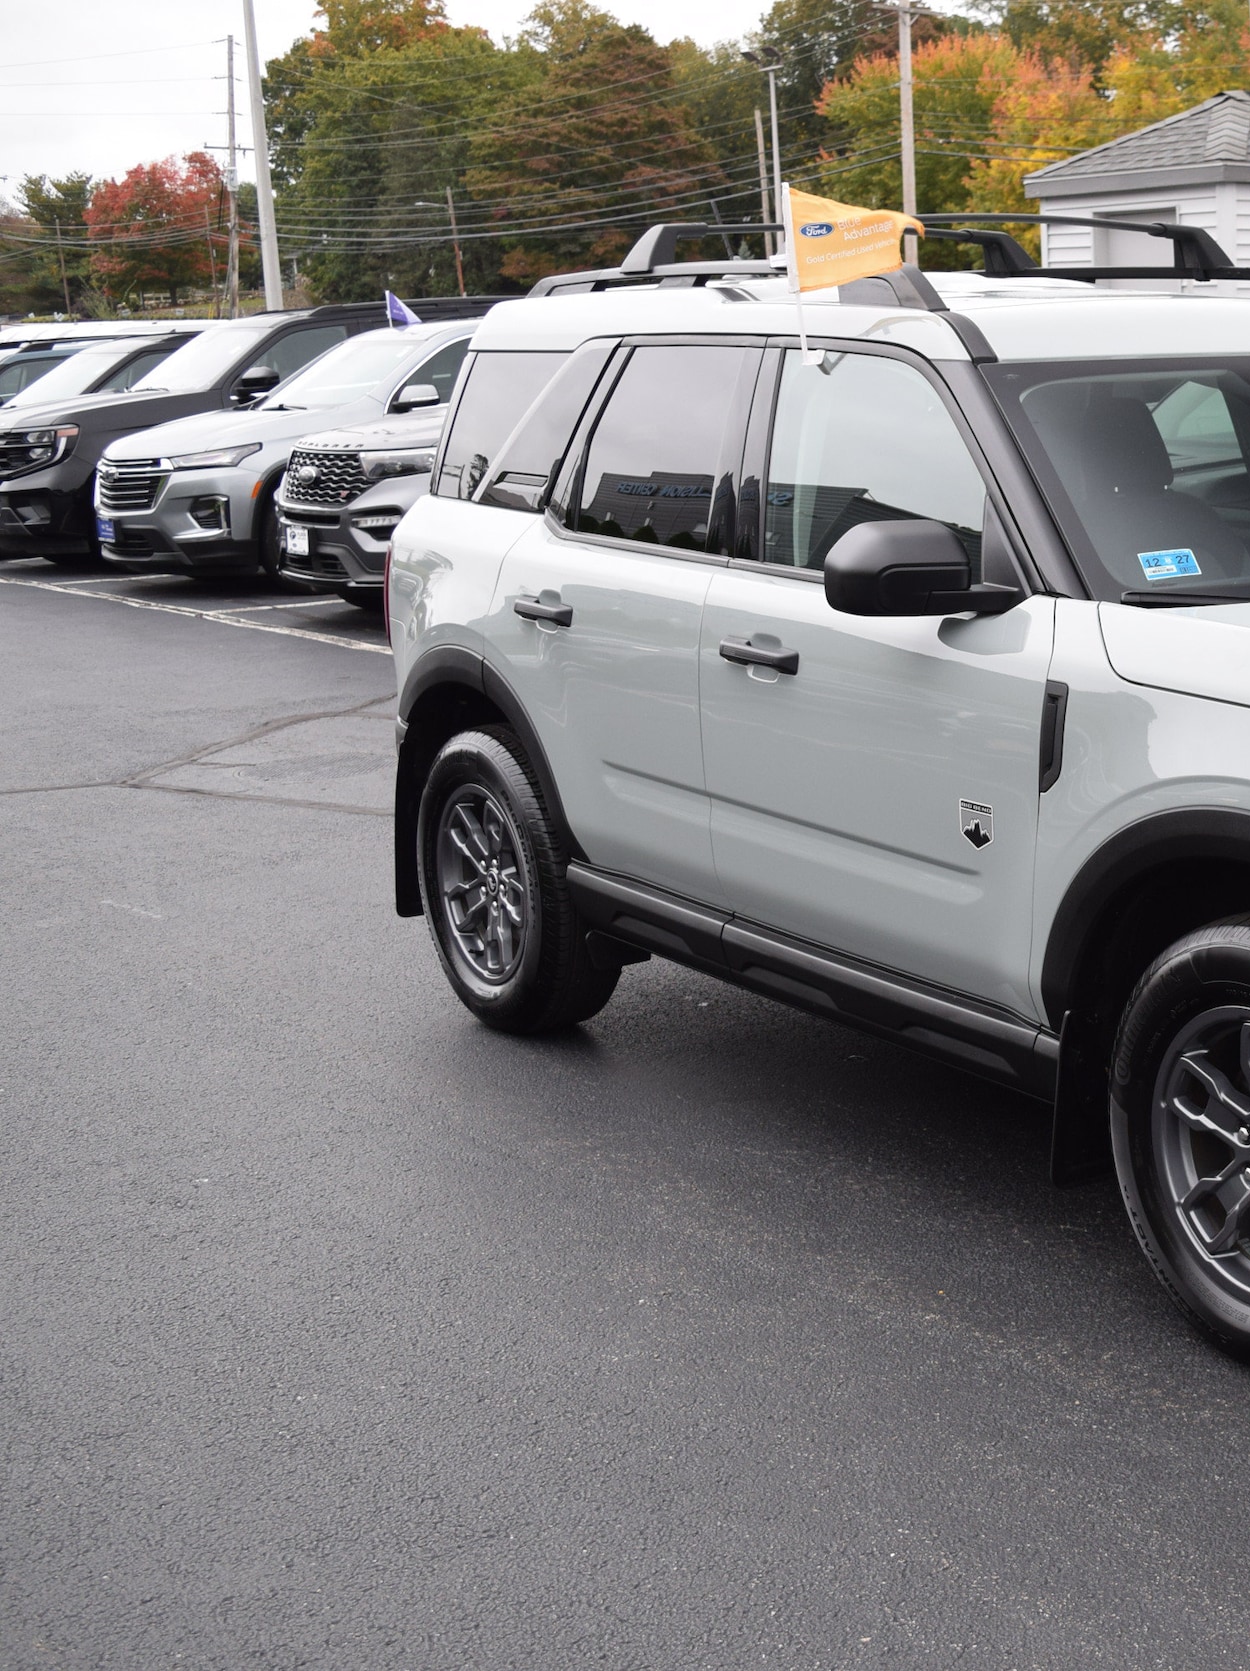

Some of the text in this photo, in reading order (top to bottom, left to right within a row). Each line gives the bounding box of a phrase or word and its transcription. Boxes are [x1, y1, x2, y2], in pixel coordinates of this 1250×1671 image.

[837, 216, 862, 230] Blue
[805, 225, 828, 236] Ford
[843, 220, 894, 241] Advantage
[806, 254, 825, 264] Gold
[826, 248, 856, 261] Certified
[1145, 554, 1190, 568] 12 27
